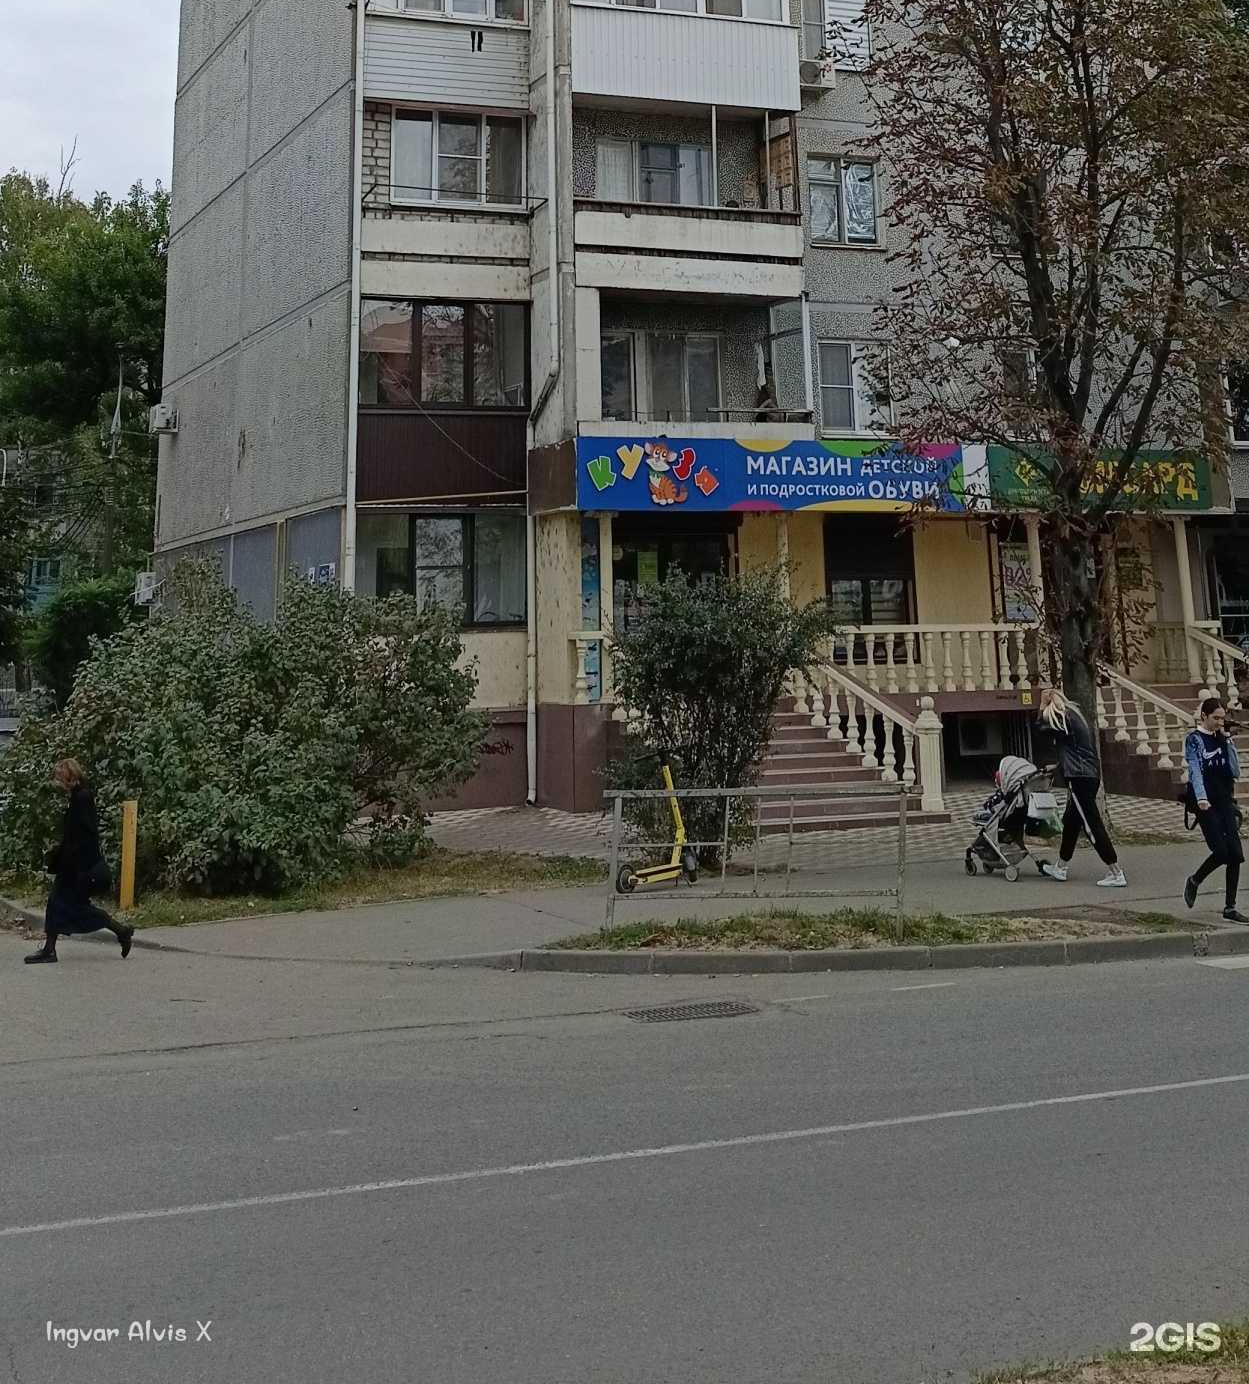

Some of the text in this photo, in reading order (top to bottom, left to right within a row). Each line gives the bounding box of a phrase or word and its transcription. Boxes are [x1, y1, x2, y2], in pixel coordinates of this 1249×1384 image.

[746, 455, 938, 477] МАГАЗИН ДЕТСКОЙ
[747, 480, 940, 499] И ПОДРОСТКОВОЙ ОБУВИ
